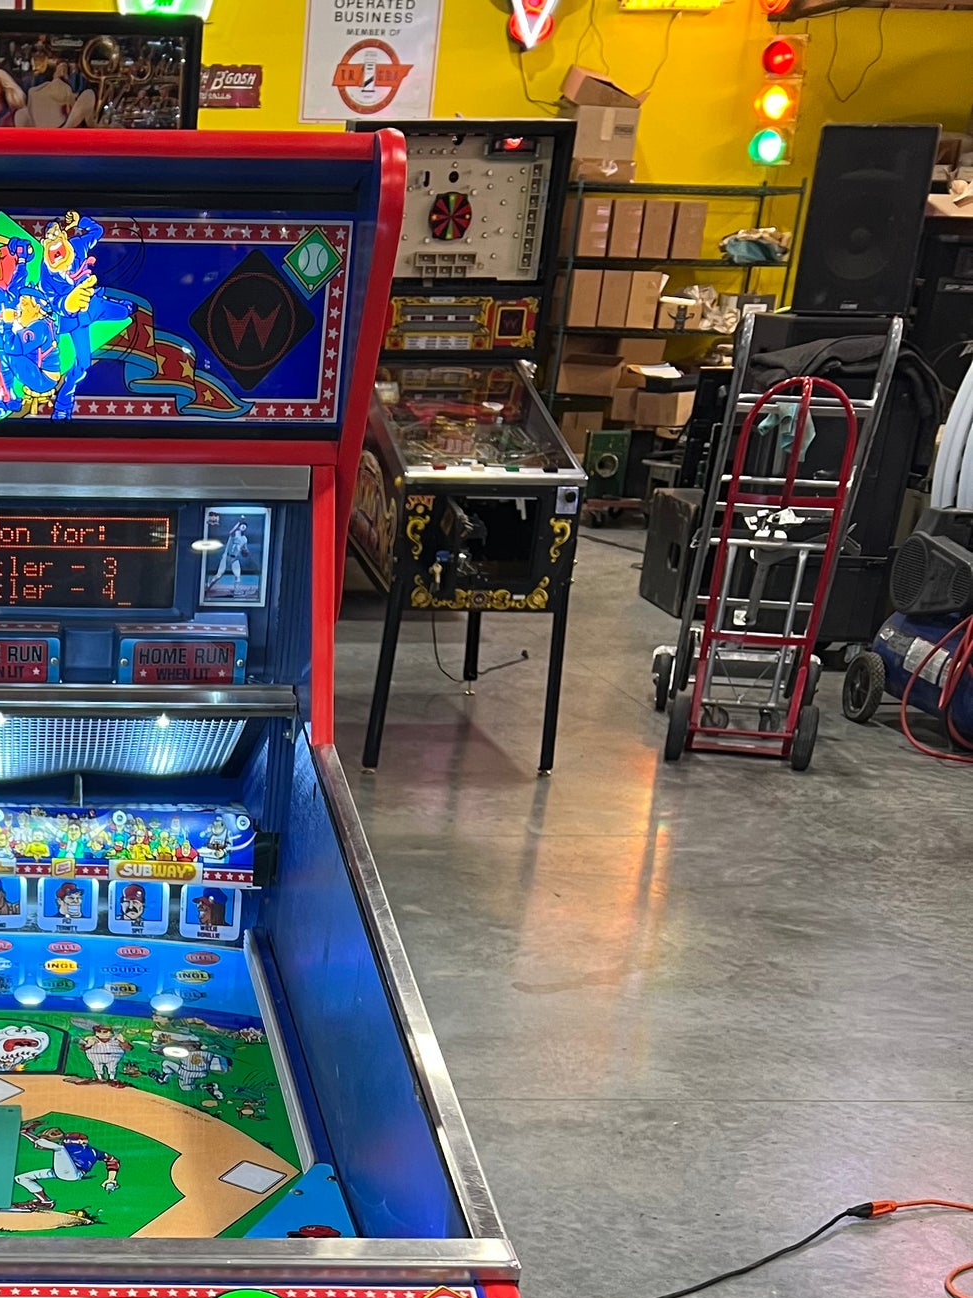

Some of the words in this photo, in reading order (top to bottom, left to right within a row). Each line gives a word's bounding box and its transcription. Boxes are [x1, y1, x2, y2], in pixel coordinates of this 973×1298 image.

[334, 0, 416, 10] OPERATED
[334, 11, 414, 24] BUSINESS
[346, 28, 386, 36] MEMBER
[389, 28, 402, 37] OF
[50, 522, 106, 544] for:
[103, 557, 118, 578] 3
[102, 579, 117, 600] 4
[7, 646, 43, 664] RUN
[139, 647, 188, 665] HOME
[194, 648, 230, 665] RUN
[7, 667, 25, 679] LIT
[156, 667, 191, 681] WHEN
[193, 668, 211, 681] LIT
[119, 862, 188, 879] SUBWAY
